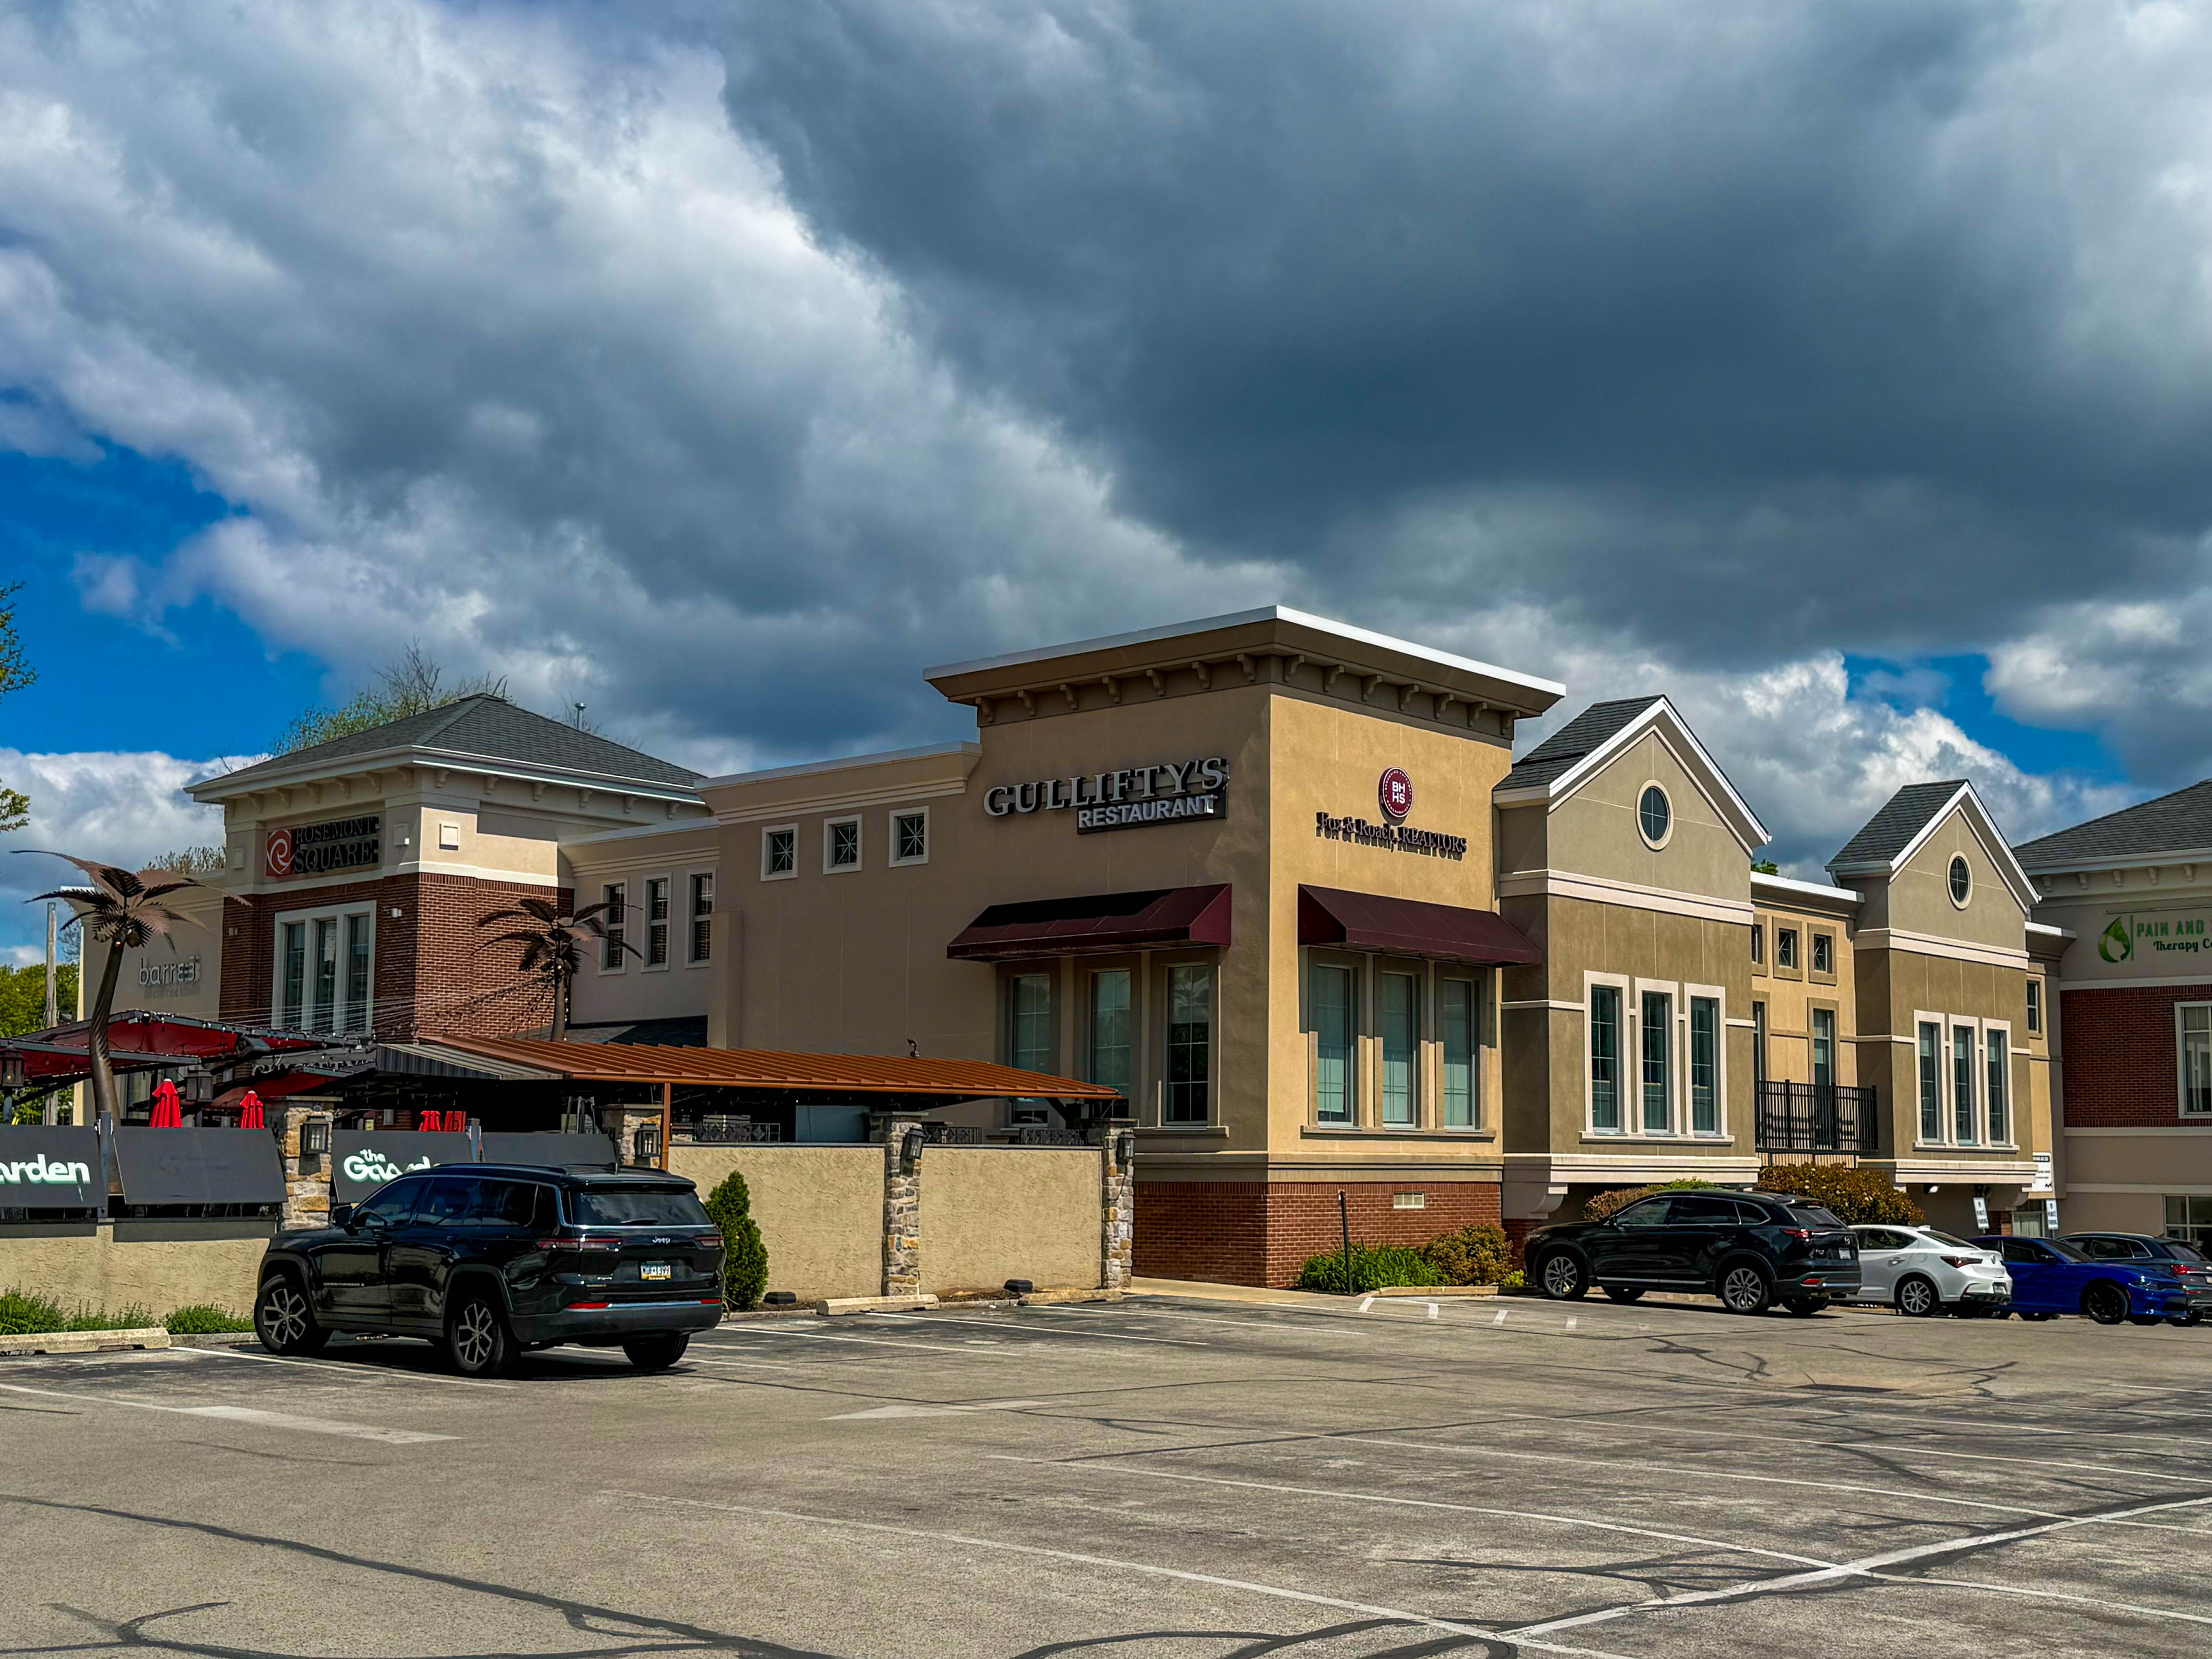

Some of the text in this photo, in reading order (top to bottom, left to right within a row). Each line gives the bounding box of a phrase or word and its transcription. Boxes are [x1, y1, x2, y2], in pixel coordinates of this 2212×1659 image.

[984, 757, 1228, 817] GULLIFTY'S
[1392, 781, 1405, 793] BH
[1392, 792, 1405, 804] HS
[1078, 795, 1217, 829] RESTAURANT
[296, 817, 374, 844] ROSEMONT
[1317, 812, 1342, 832] Fox
[1344, 817, 1354, 833] &
[1399, 827, 1467, 853] REALTORS
[294, 842, 373, 873] SQUARE
[2137, 919, 2204, 937] PAIN AND
[2153, 940, 2198, 953] Therapy
[360, 1149, 386, 1162] the
